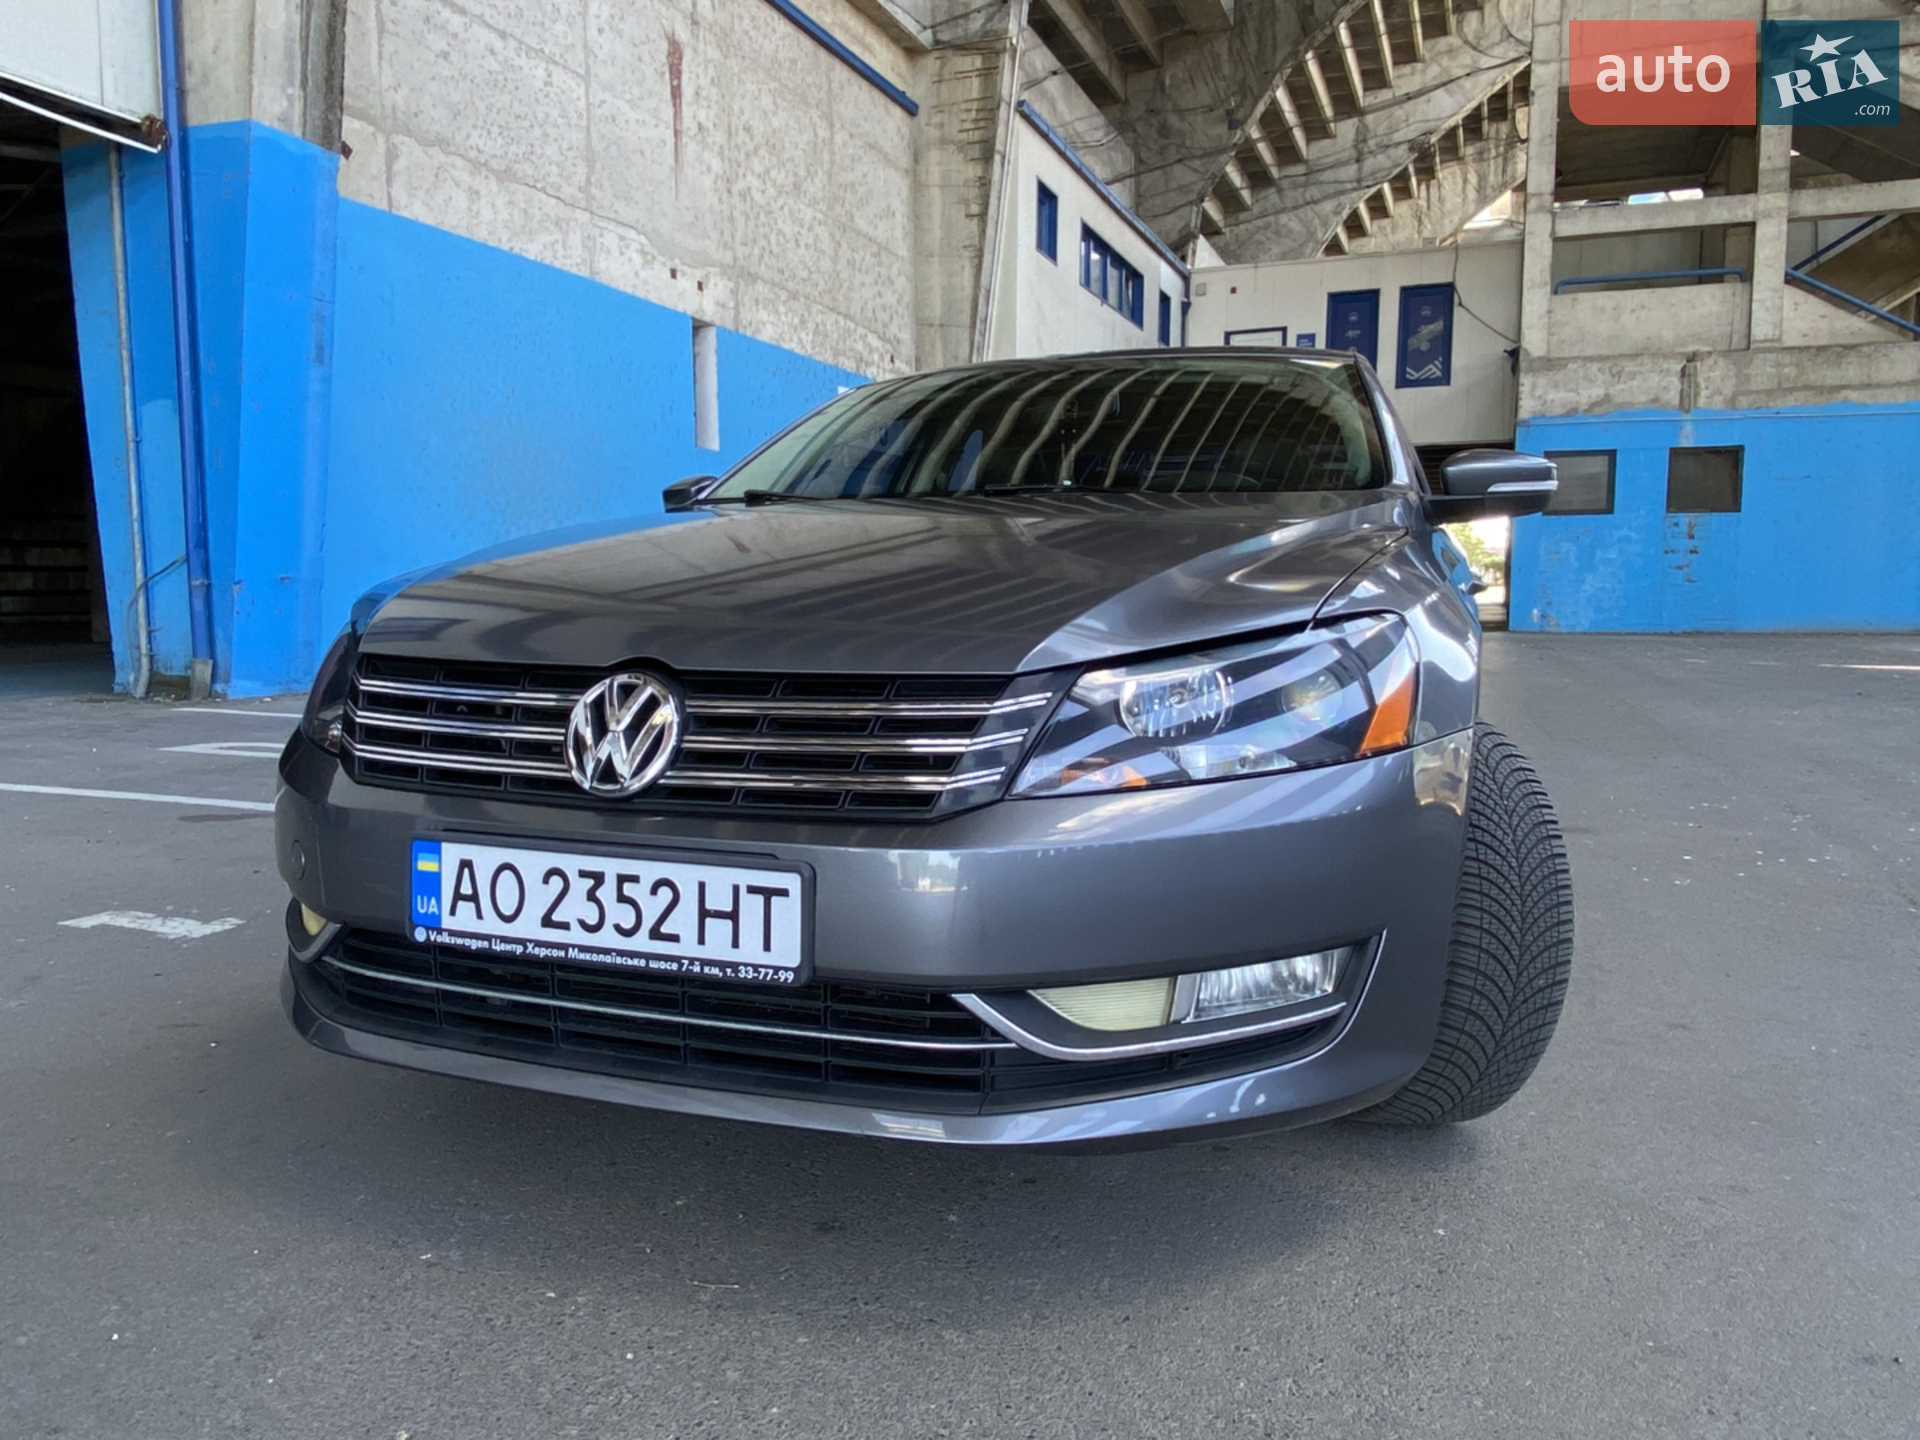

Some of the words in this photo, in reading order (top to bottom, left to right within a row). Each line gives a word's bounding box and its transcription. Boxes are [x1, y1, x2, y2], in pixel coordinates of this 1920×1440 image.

[417, 894, 439, 916] UA
[449, 858, 526, 924] AO
[540, 867, 682, 944] 2352
[697, 881, 790, 953] HT
[428, 929, 490, 950] Volkswagen
[491, 938, 524, 955] Центр
[526, 942, 566, 959] Херсон
[568, 947, 647, 968] Миколаївське
[649, 960, 679, 971] шосе
[681, 959, 701, 974] 7-й
[738, 965, 795, 984] 33-77-99
